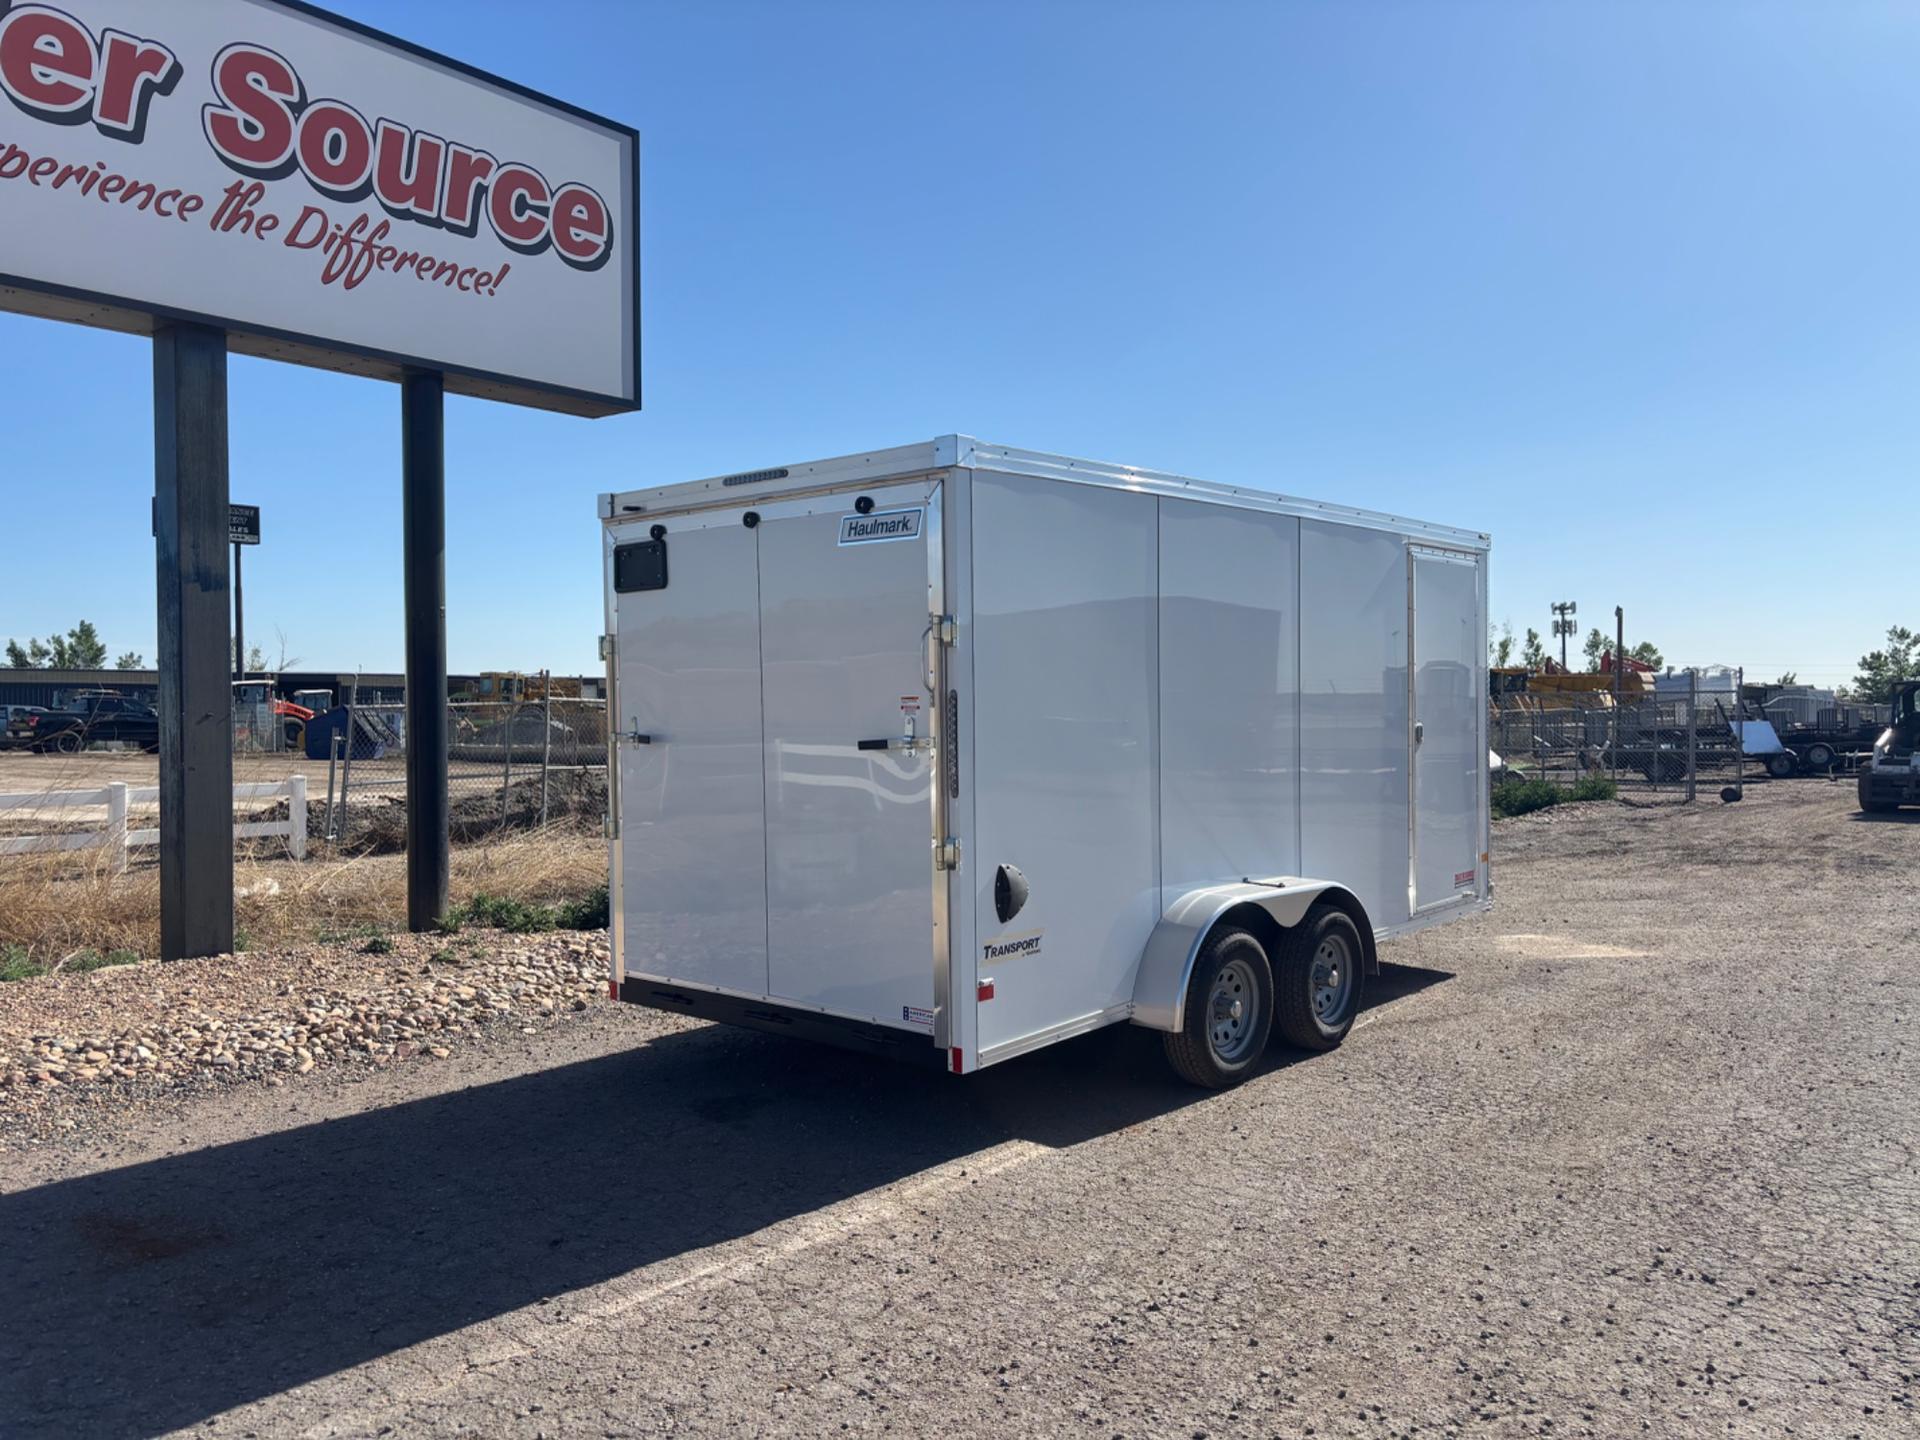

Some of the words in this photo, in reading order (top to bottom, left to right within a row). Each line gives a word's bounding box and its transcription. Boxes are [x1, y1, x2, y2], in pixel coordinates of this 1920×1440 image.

[0, 143, 204, 223] perience
[210, 180, 279, 240] the
[284, 206, 511, 297] Difference!
[202, 42, 614, 271] Source
[847, 515, 911, 537] Haulmark
